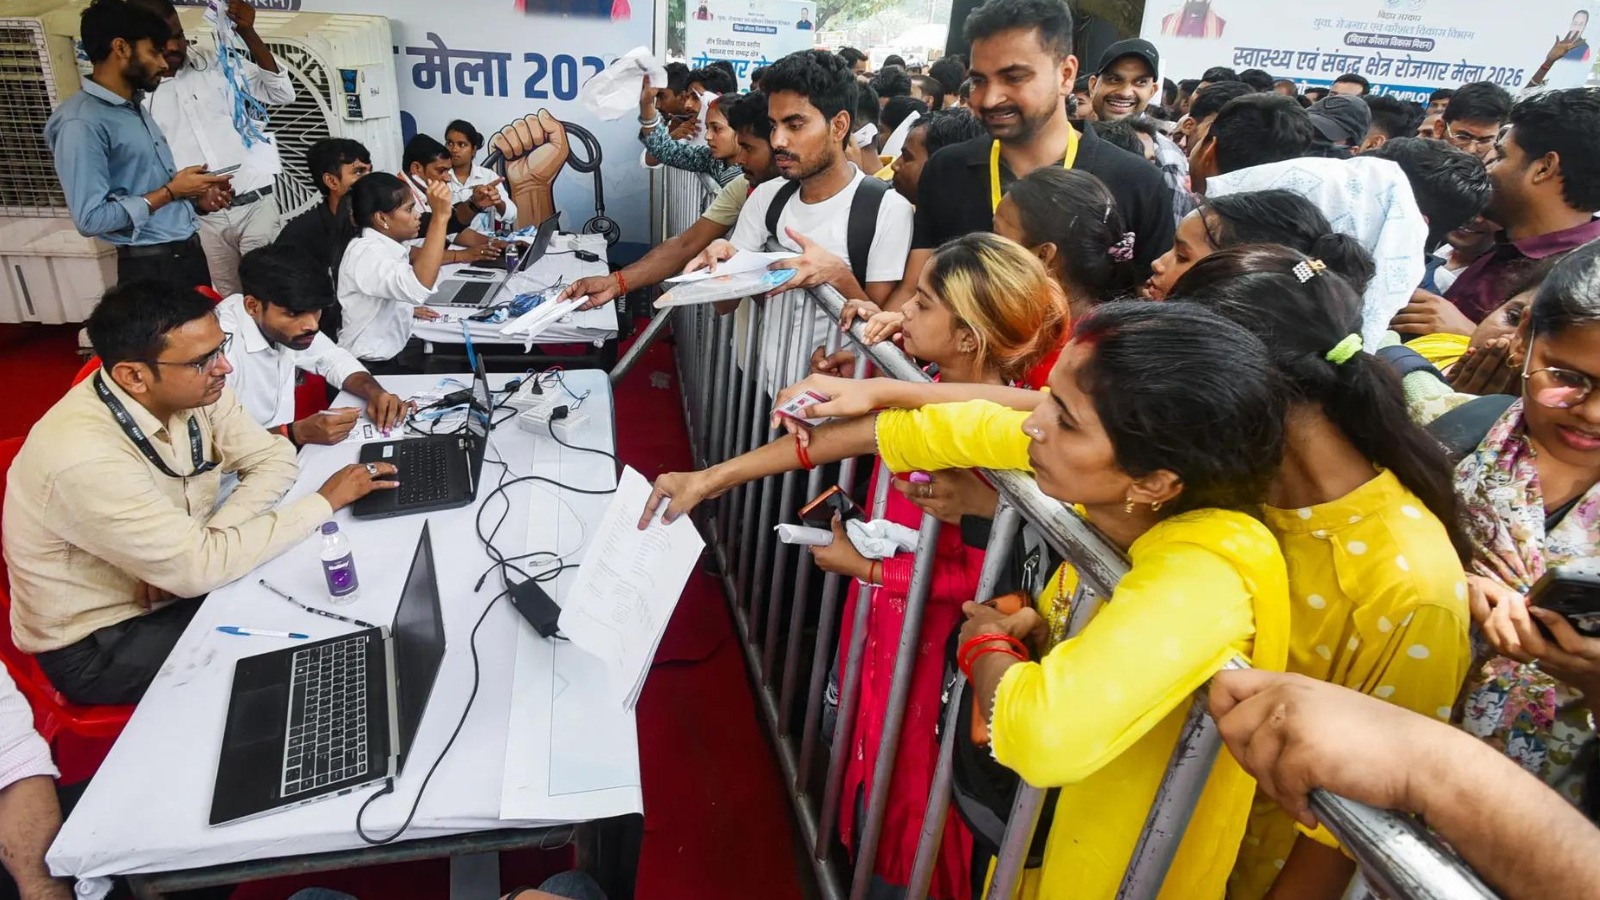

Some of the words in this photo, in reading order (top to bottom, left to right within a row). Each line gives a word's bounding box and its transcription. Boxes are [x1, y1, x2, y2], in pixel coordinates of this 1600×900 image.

[405, 32, 512, 98] मेला
[523, 52, 621, 101] 202
[1233, 46, 1295, 69] स्वास्थ्य
[1296, 47, 1321, 72] एवं
[1322, 48, 1364, 75] संबद्ध
[1365, 51, 1394, 77] क्षेत्र
[1395, 53, 1451, 80] रोजगार
[1451, 58, 1486, 84] मेला
[1486, 66, 1525, 87] 2026
